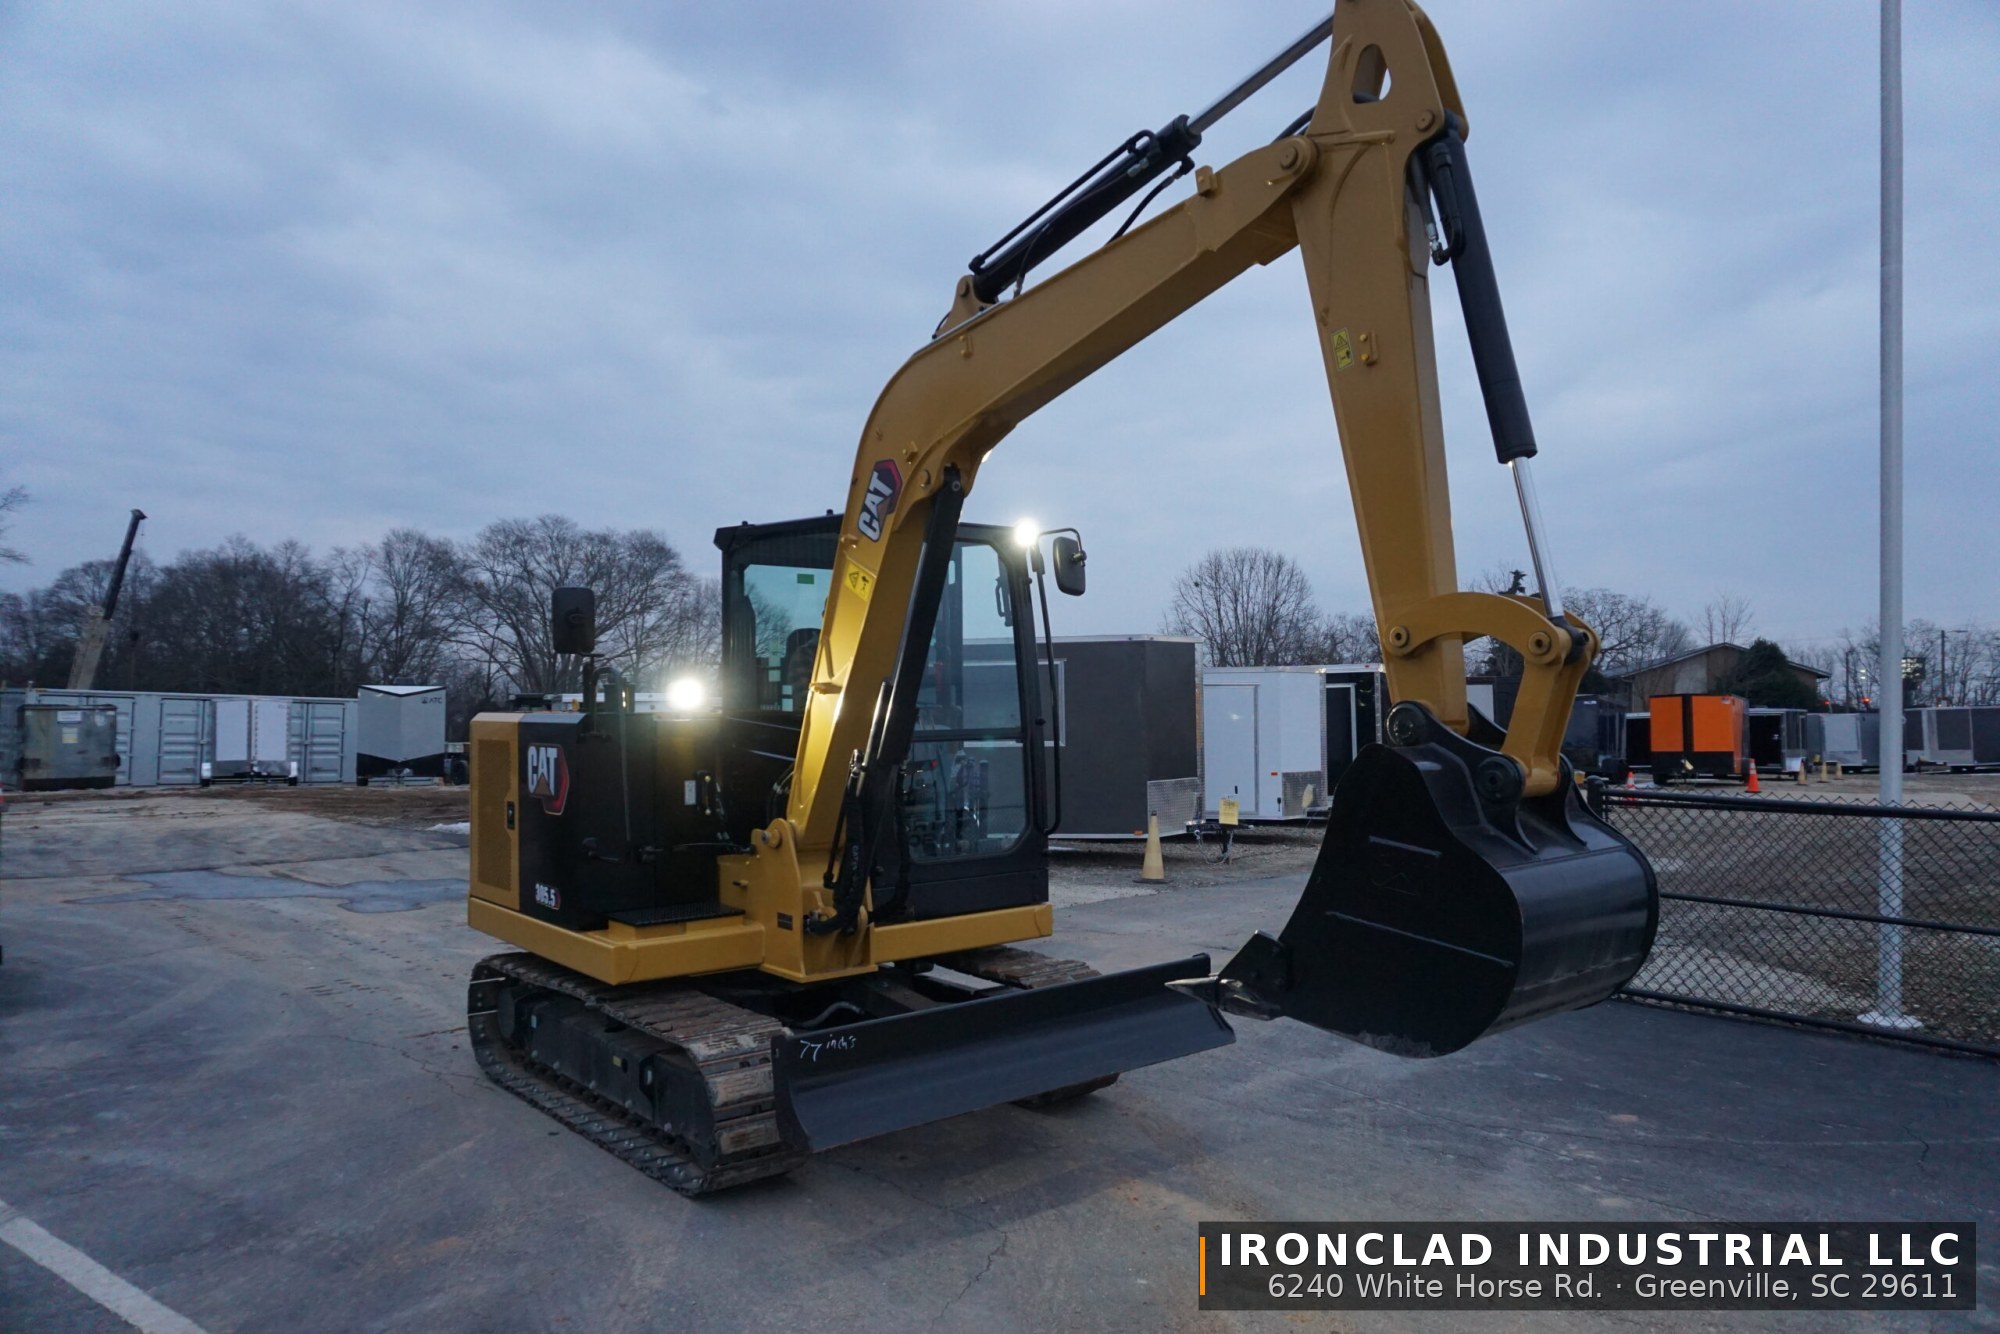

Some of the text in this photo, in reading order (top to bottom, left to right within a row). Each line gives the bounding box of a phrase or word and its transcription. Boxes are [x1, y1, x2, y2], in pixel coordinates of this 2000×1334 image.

[858, 471, 893, 541] CAT
[528, 746, 558, 796] CAT
[800, 1039, 823, 1062] 77
